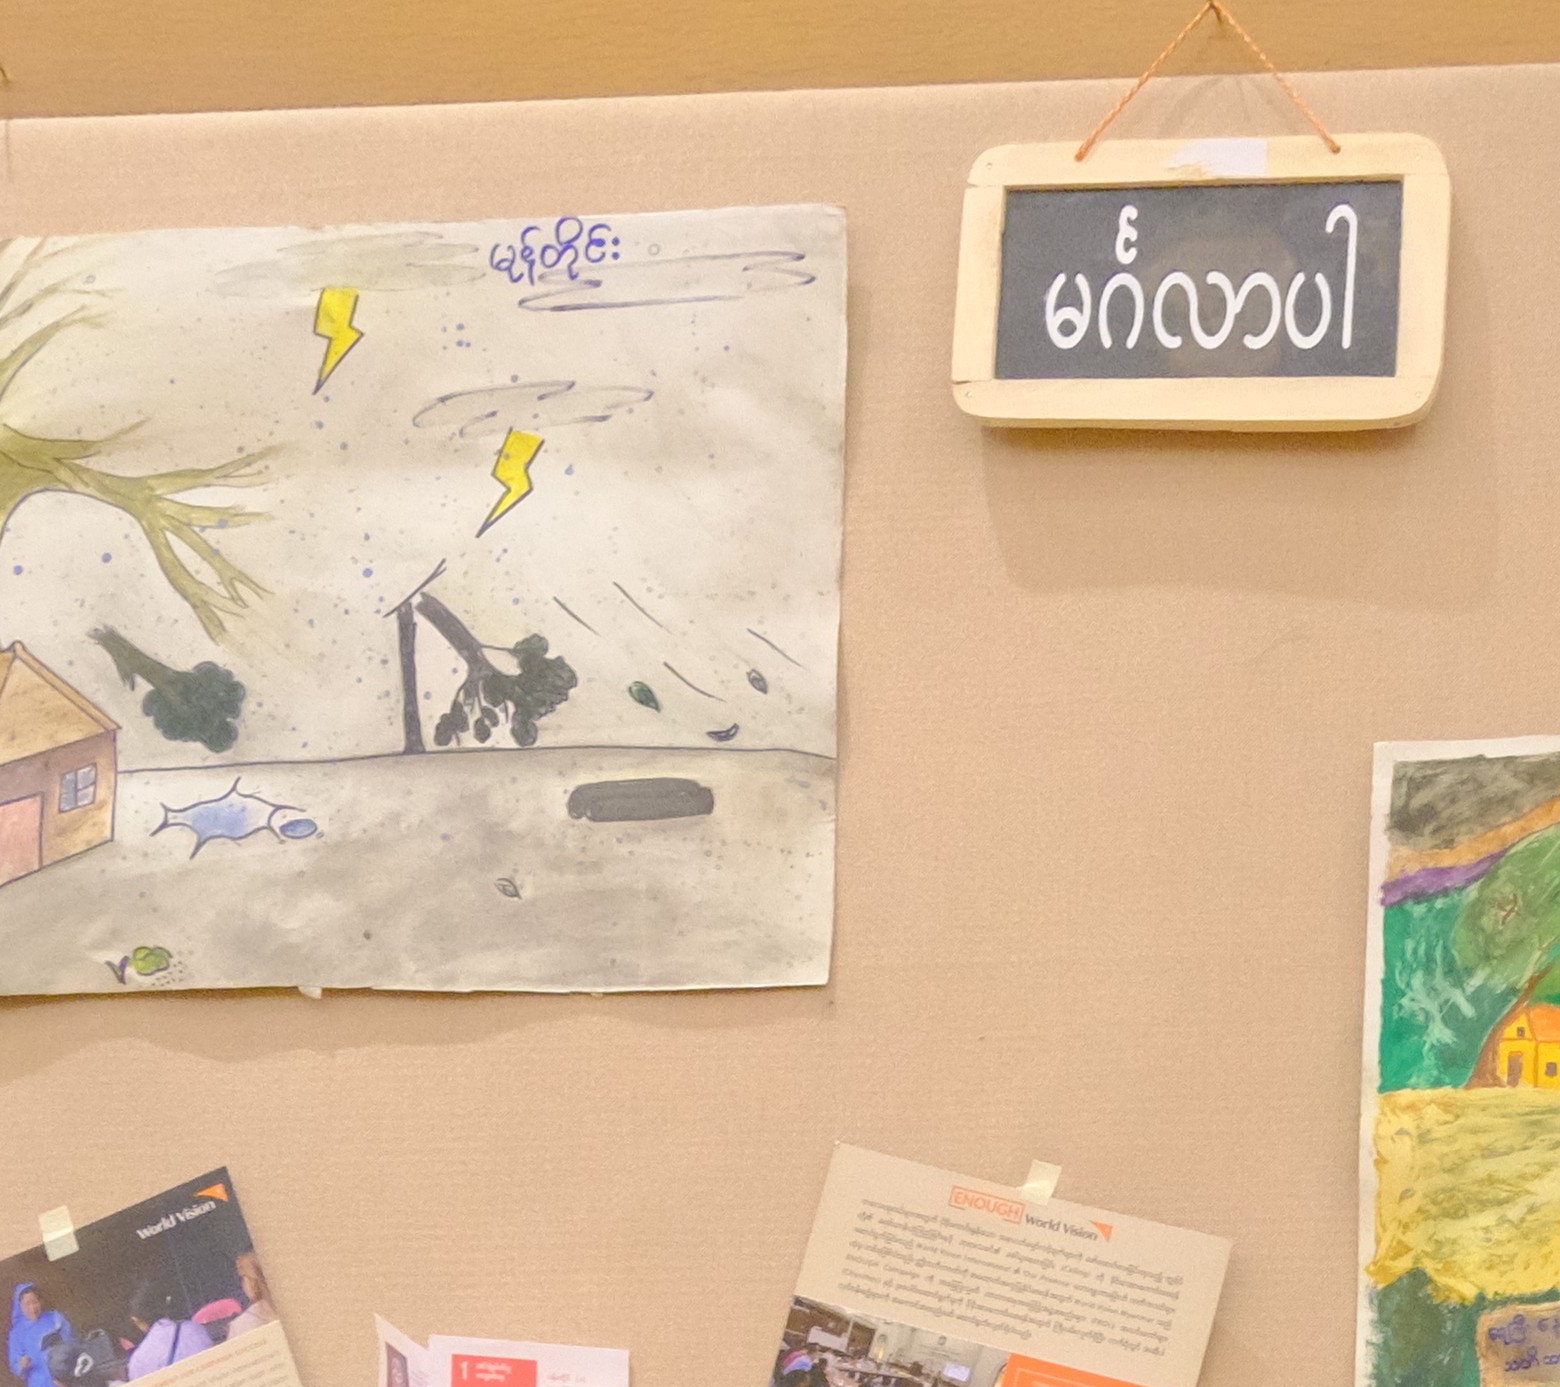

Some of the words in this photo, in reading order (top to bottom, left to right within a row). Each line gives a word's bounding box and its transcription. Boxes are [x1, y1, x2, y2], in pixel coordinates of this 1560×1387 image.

[1044, 203, 1358, 350] မင်္ဂလာပါ
[135, 1213, 177, 1241] World
[176, 1200, 217, 1226] Vision
[952, 1188, 1025, 1220] ENOUGH
[1025, 1213, 1060, 1233] World
[1061, 1221, 1099, 1243] Vision
